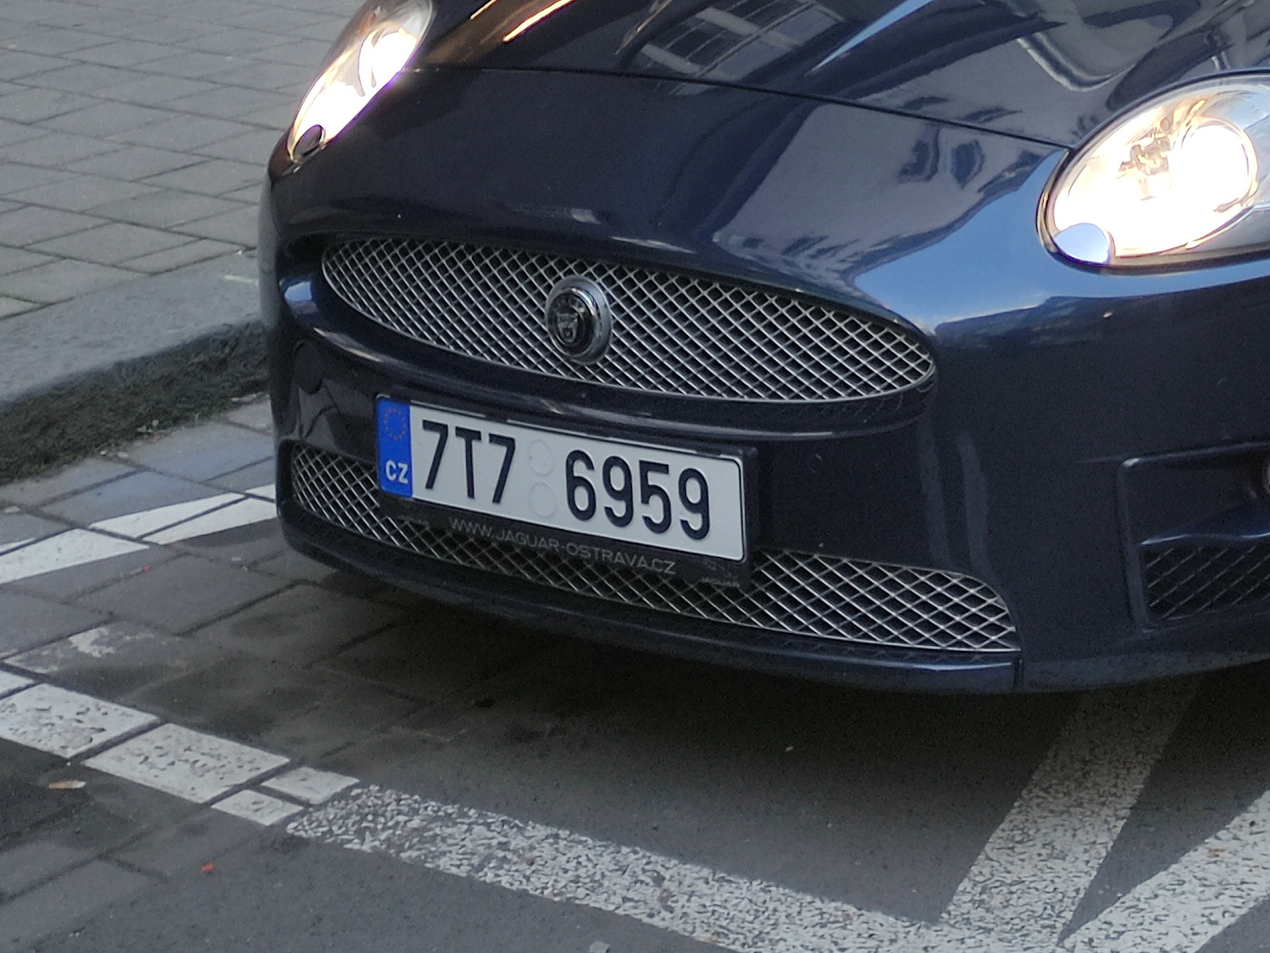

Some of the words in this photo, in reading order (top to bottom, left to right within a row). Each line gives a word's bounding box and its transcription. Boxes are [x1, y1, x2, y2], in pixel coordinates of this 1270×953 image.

[385, 459, 409, 485] CZ
[421, 419, 517, 505] 7T7
[565, 449, 711, 541] 6959
[450, 517, 677, 575] WWW.JAGUAR-OSTRAVA.CZ
